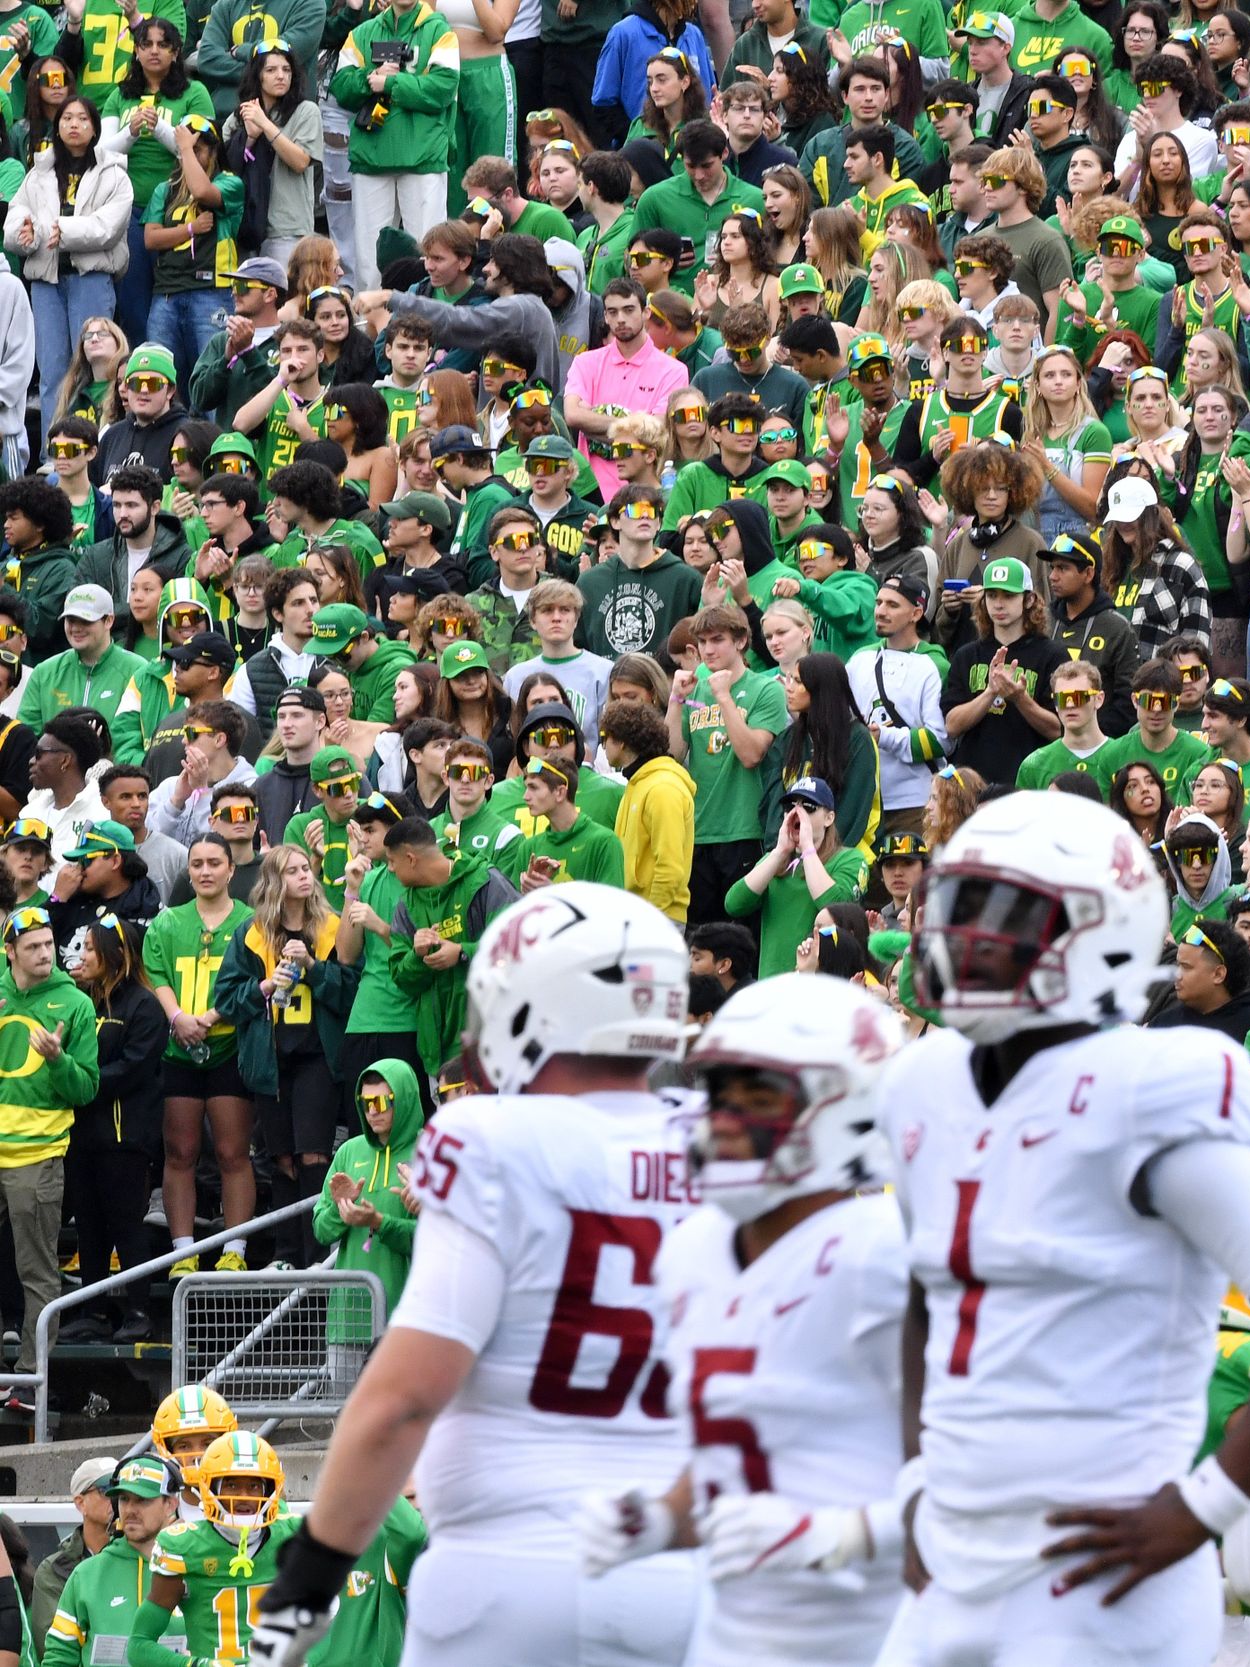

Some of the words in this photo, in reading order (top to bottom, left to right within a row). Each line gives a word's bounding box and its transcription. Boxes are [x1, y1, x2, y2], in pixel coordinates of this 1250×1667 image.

[1088, 636, 1104, 650] O
[1163, 767, 1177, 781] O
[472, 836, 490, 850] O
[528, 1207, 673, 1420] 6
